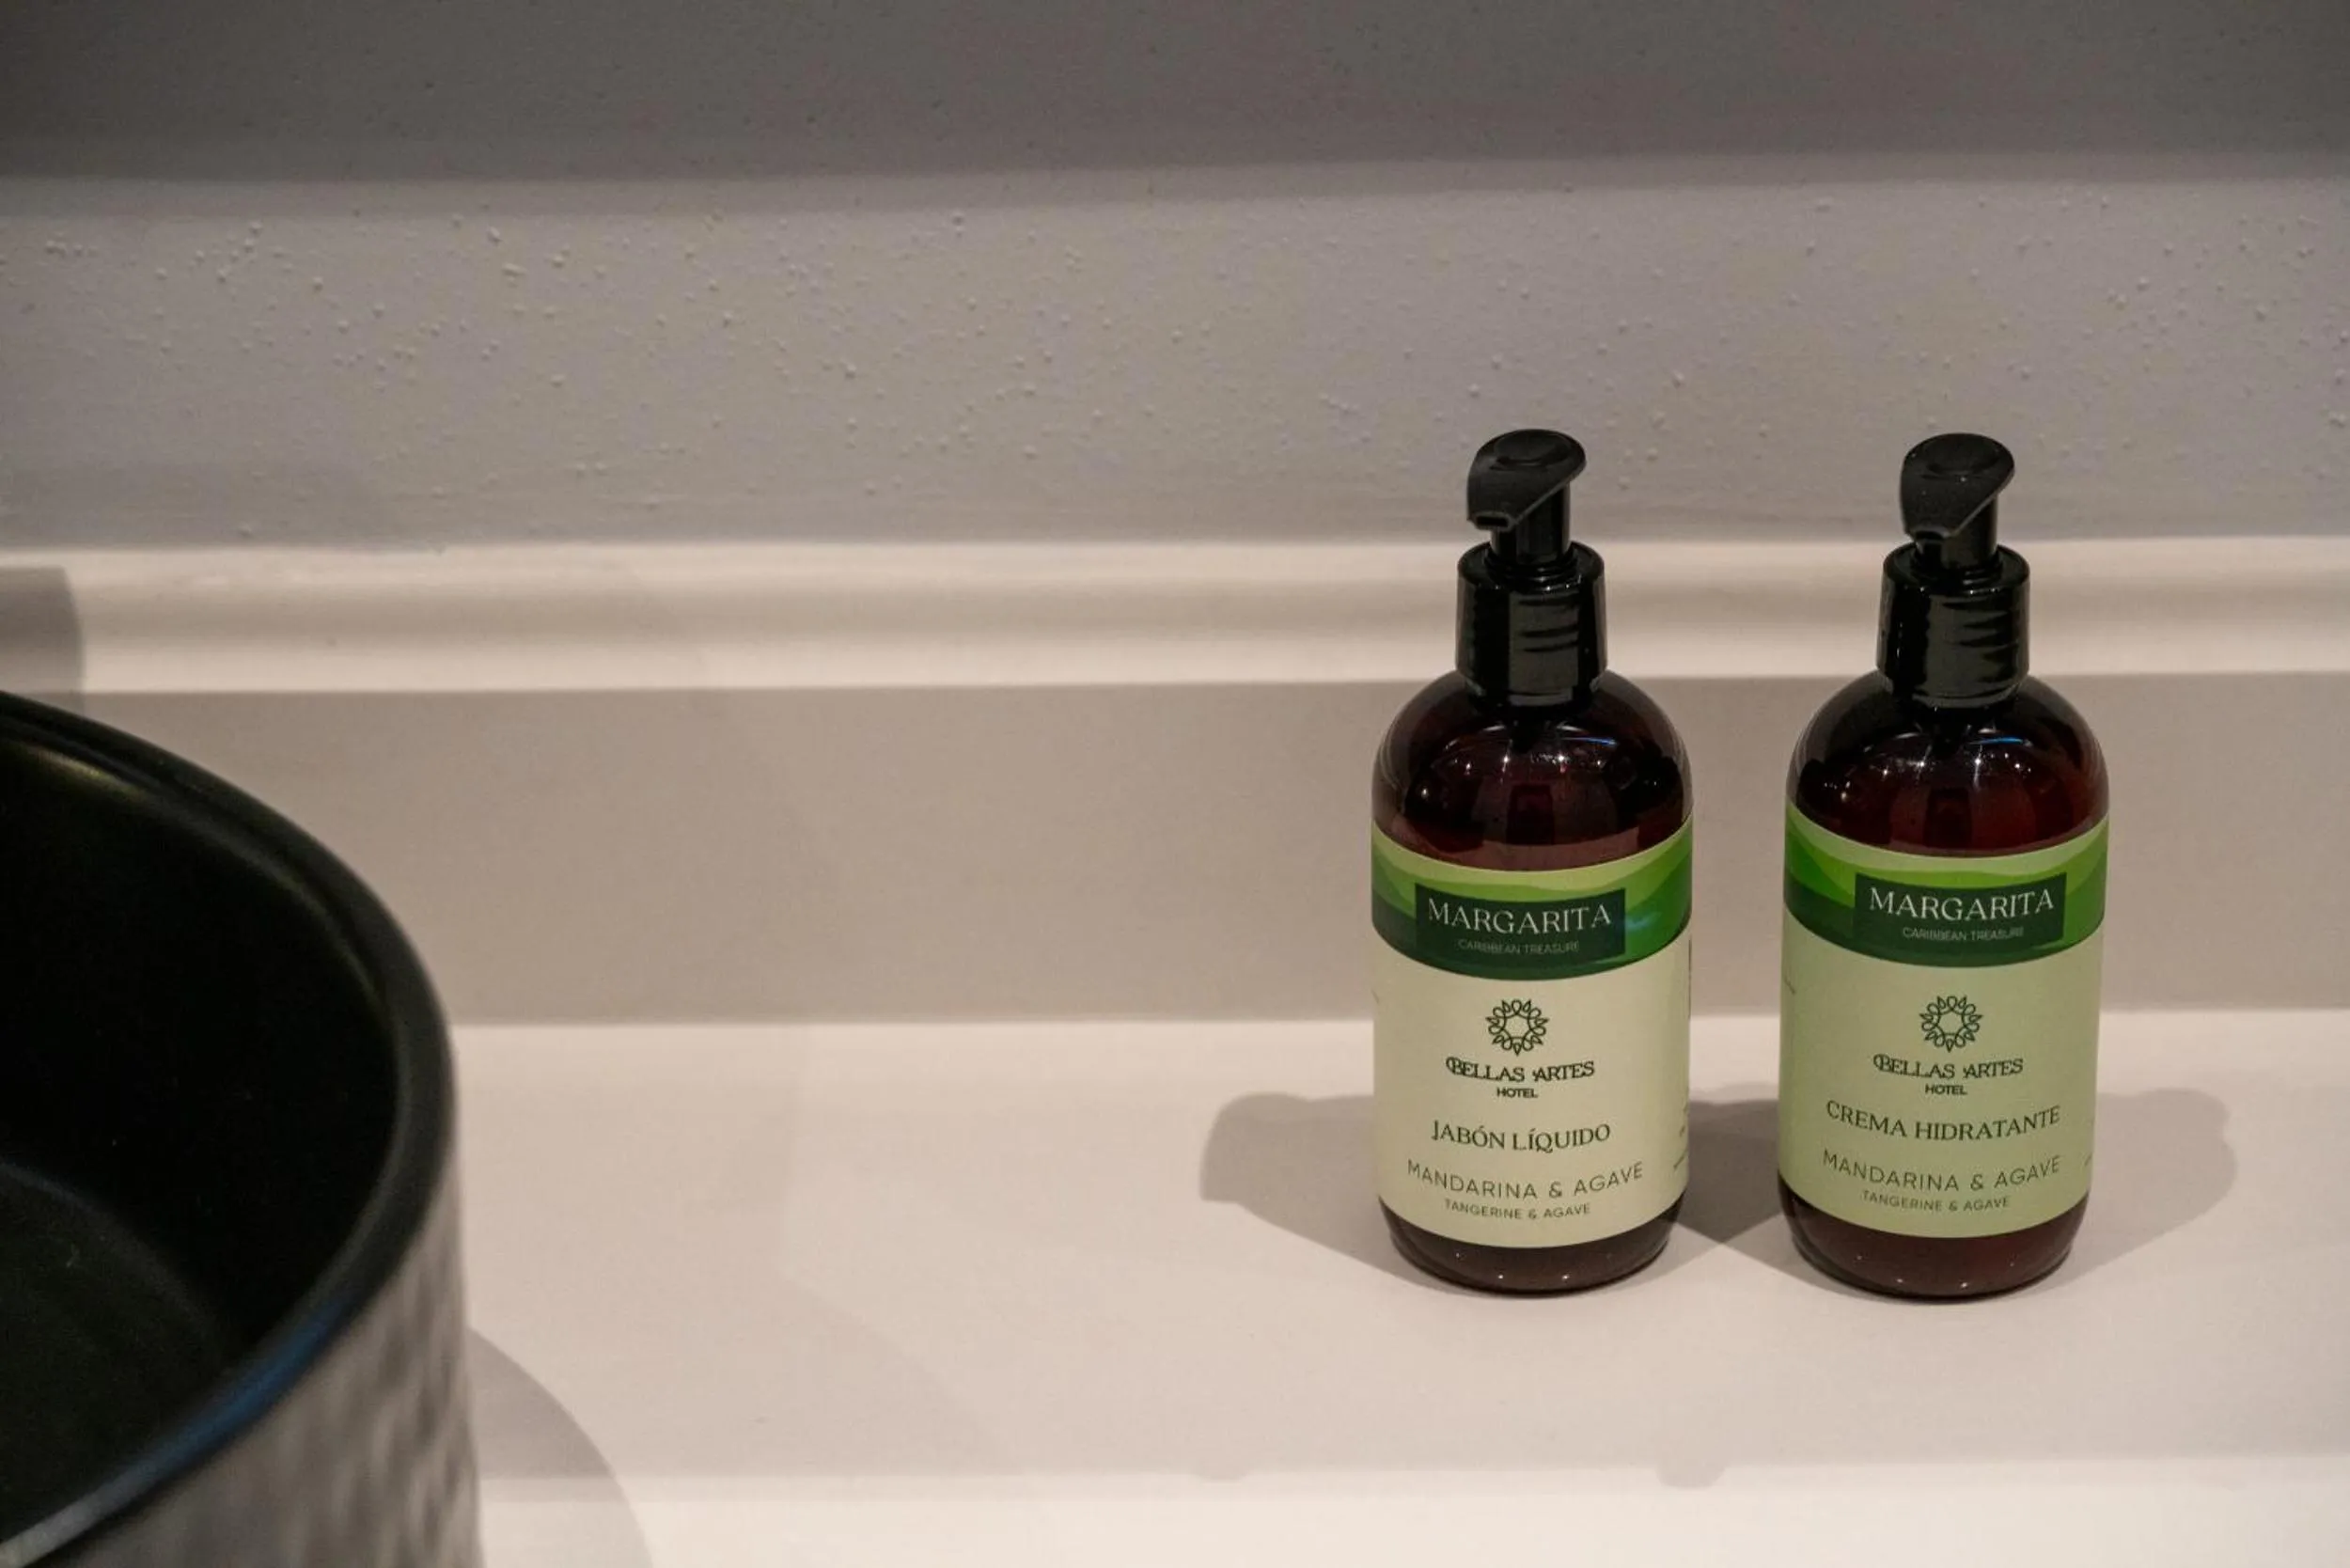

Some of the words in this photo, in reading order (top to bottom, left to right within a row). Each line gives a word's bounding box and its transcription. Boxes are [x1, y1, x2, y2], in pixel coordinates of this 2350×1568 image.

[1428, 898, 1611, 935] MARGARITA
[1869, 887, 2055, 921] MARGARITA
[1496, 1087, 1539, 1099] HOTEL
[1925, 1083, 1968, 1095] HOTEL
[1431, 1120, 1506, 1150] JABÓN
[1512, 1124, 1610, 1153] LÍQUIDO
[1826, 1100, 1907, 1137] CREMA
[1915, 1105, 2061, 1141] HIDRATANTE
[1407, 1159, 1538, 1200] MANDARINA
[1548, 1182, 1563, 1199] &
[1574, 1161, 1643, 1197] AGAVE
[1823, 1149, 1960, 1191] MANDARINA
[1970, 1174, 1984, 1191] &
[1994, 1154, 2060, 1189] AGAVE
[1445, 1199, 1523, 1220] TANGERINE
[1528, 1209, 1538, 1220] &
[1543, 1202, 1591, 1218] AGAVE
[1862, 1189, 1942, 1212] TANGERINE
[1948, 1200, 1958, 1212] &
[1963, 1196, 2010, 1212] AGAVE
